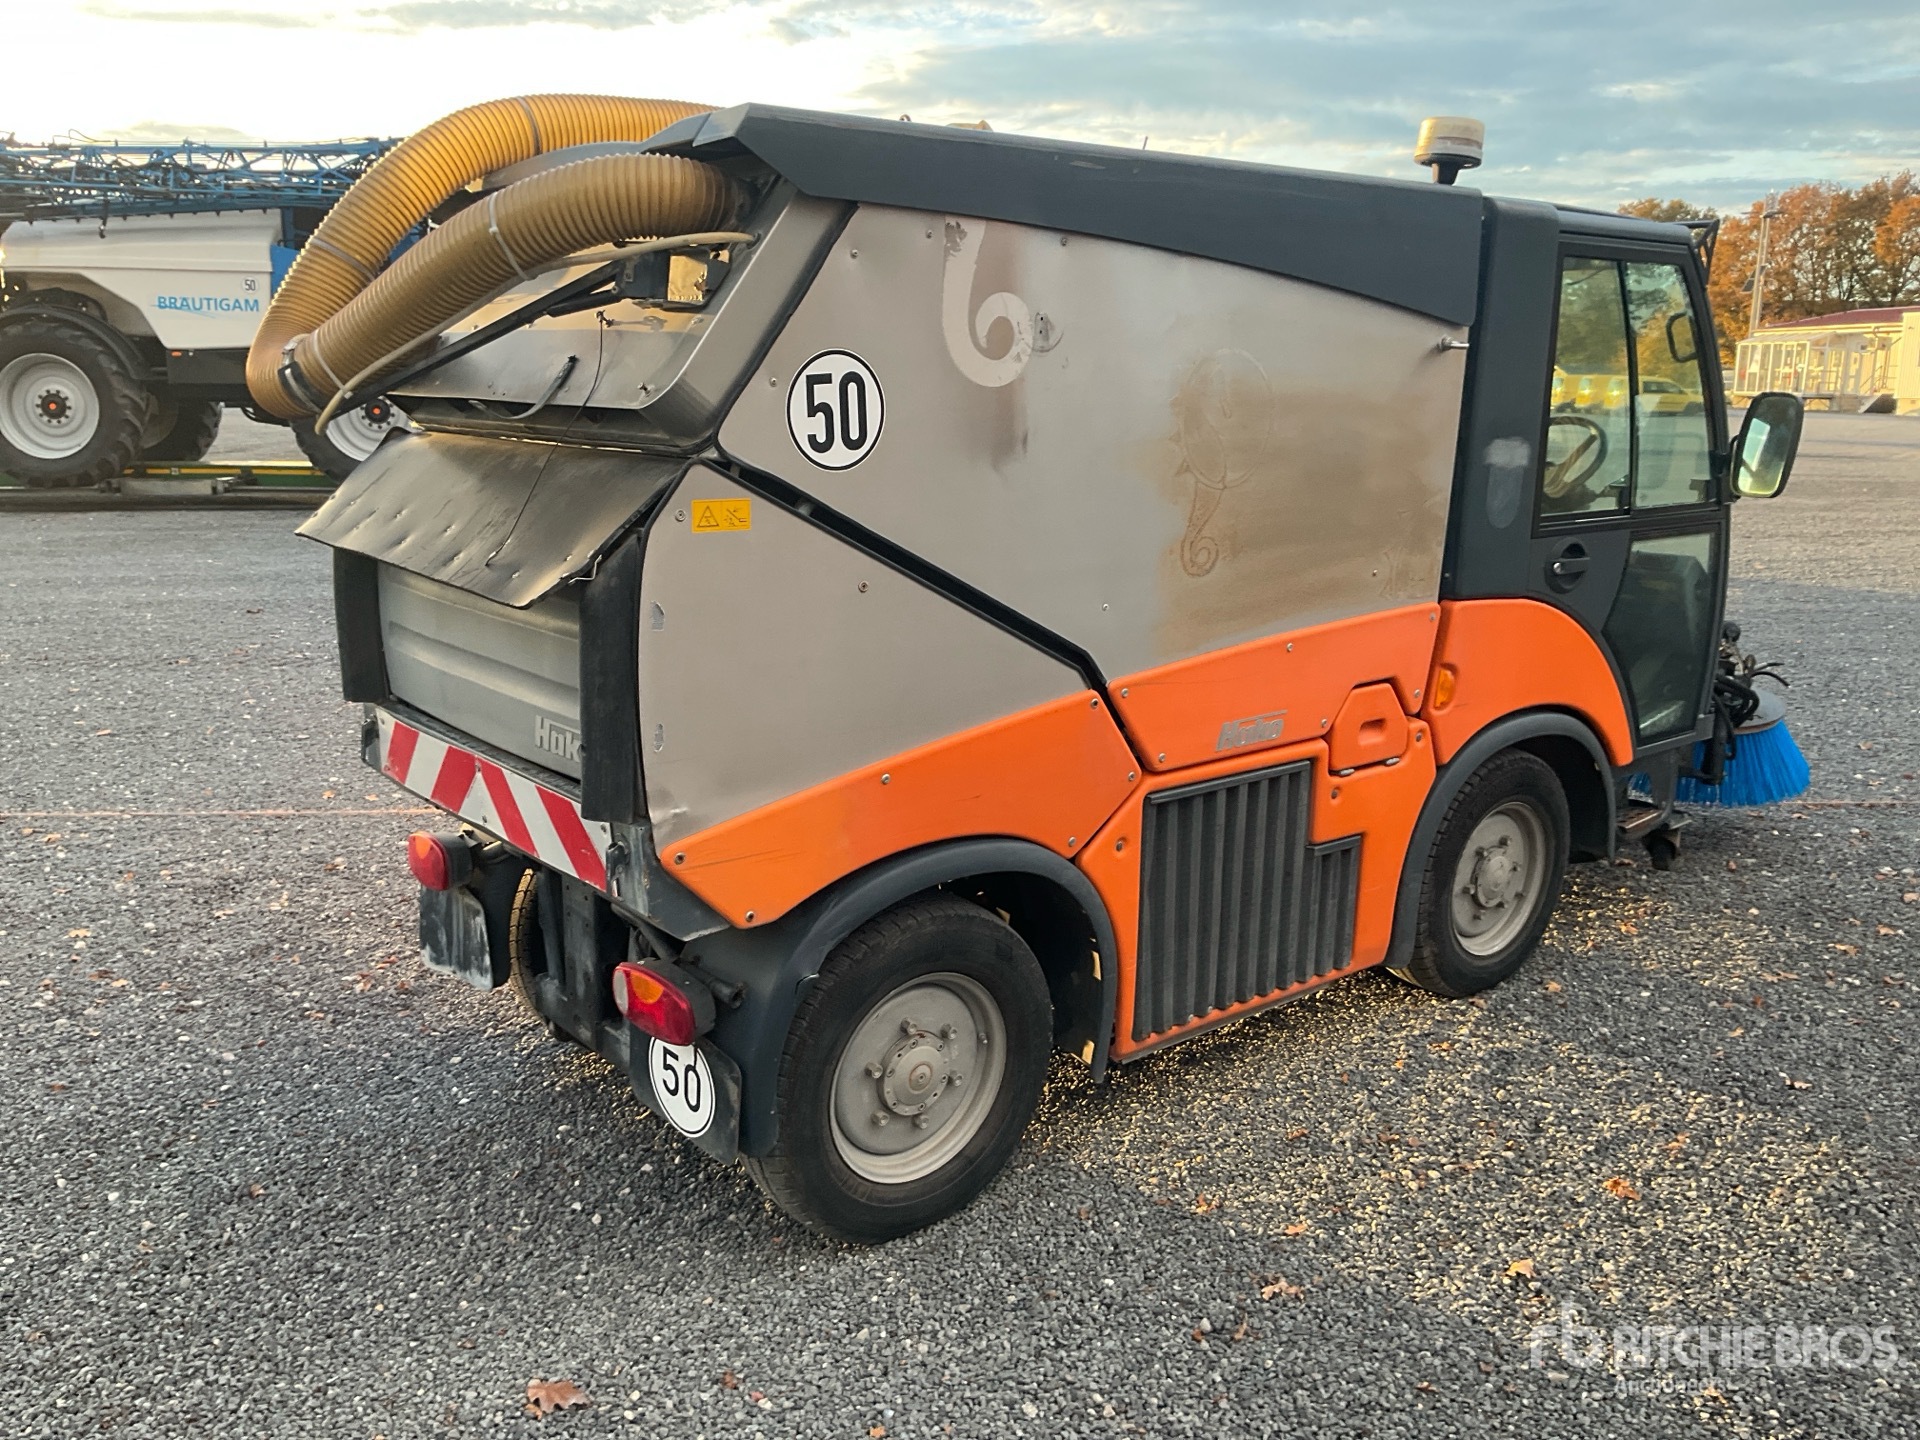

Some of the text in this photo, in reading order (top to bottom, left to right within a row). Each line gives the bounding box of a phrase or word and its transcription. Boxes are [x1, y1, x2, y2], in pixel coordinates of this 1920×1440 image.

[244, 279, 256, 291] 50
[805, 371, 868, 454] 50
[534, 714, 581, 763] Hak
[1216, 709, 1288, 752] Hako
[662, 1045, 701, 1113] 50
